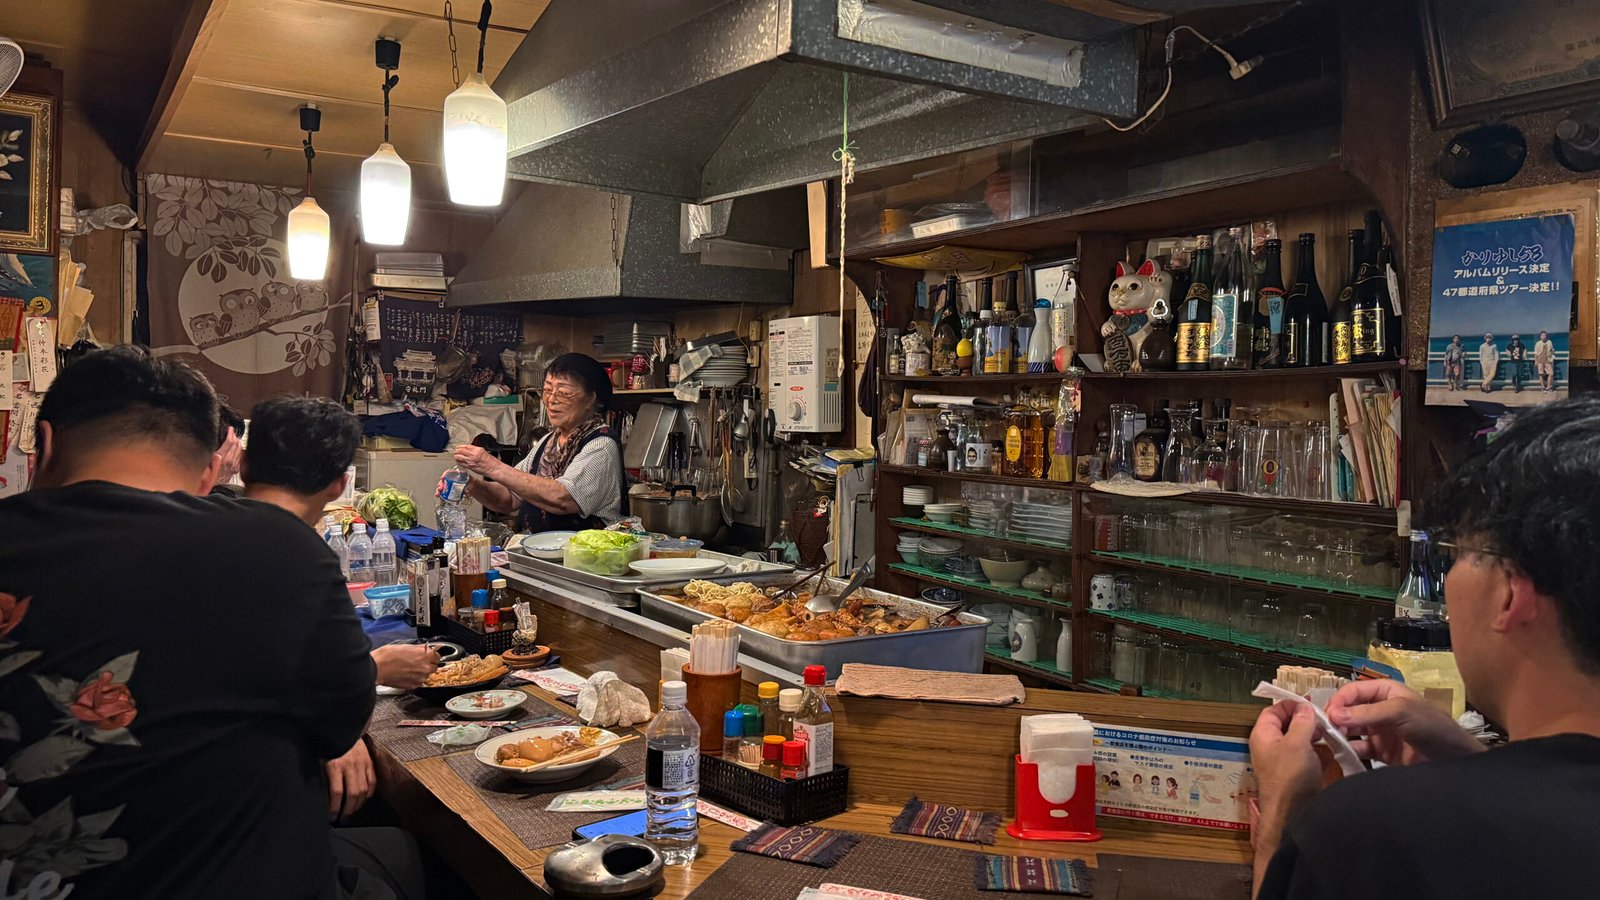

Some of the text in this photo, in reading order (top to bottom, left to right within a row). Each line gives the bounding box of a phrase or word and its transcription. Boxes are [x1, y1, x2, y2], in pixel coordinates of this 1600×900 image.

[1462, 244, 1544, 266] かりゆし58
[1454, 263, 1550, 279] アルバムリリース決定
[1495, 276, 1505, 285] &
[1442, 281, 1560, 297] 47都道府県ツアー決定!!
